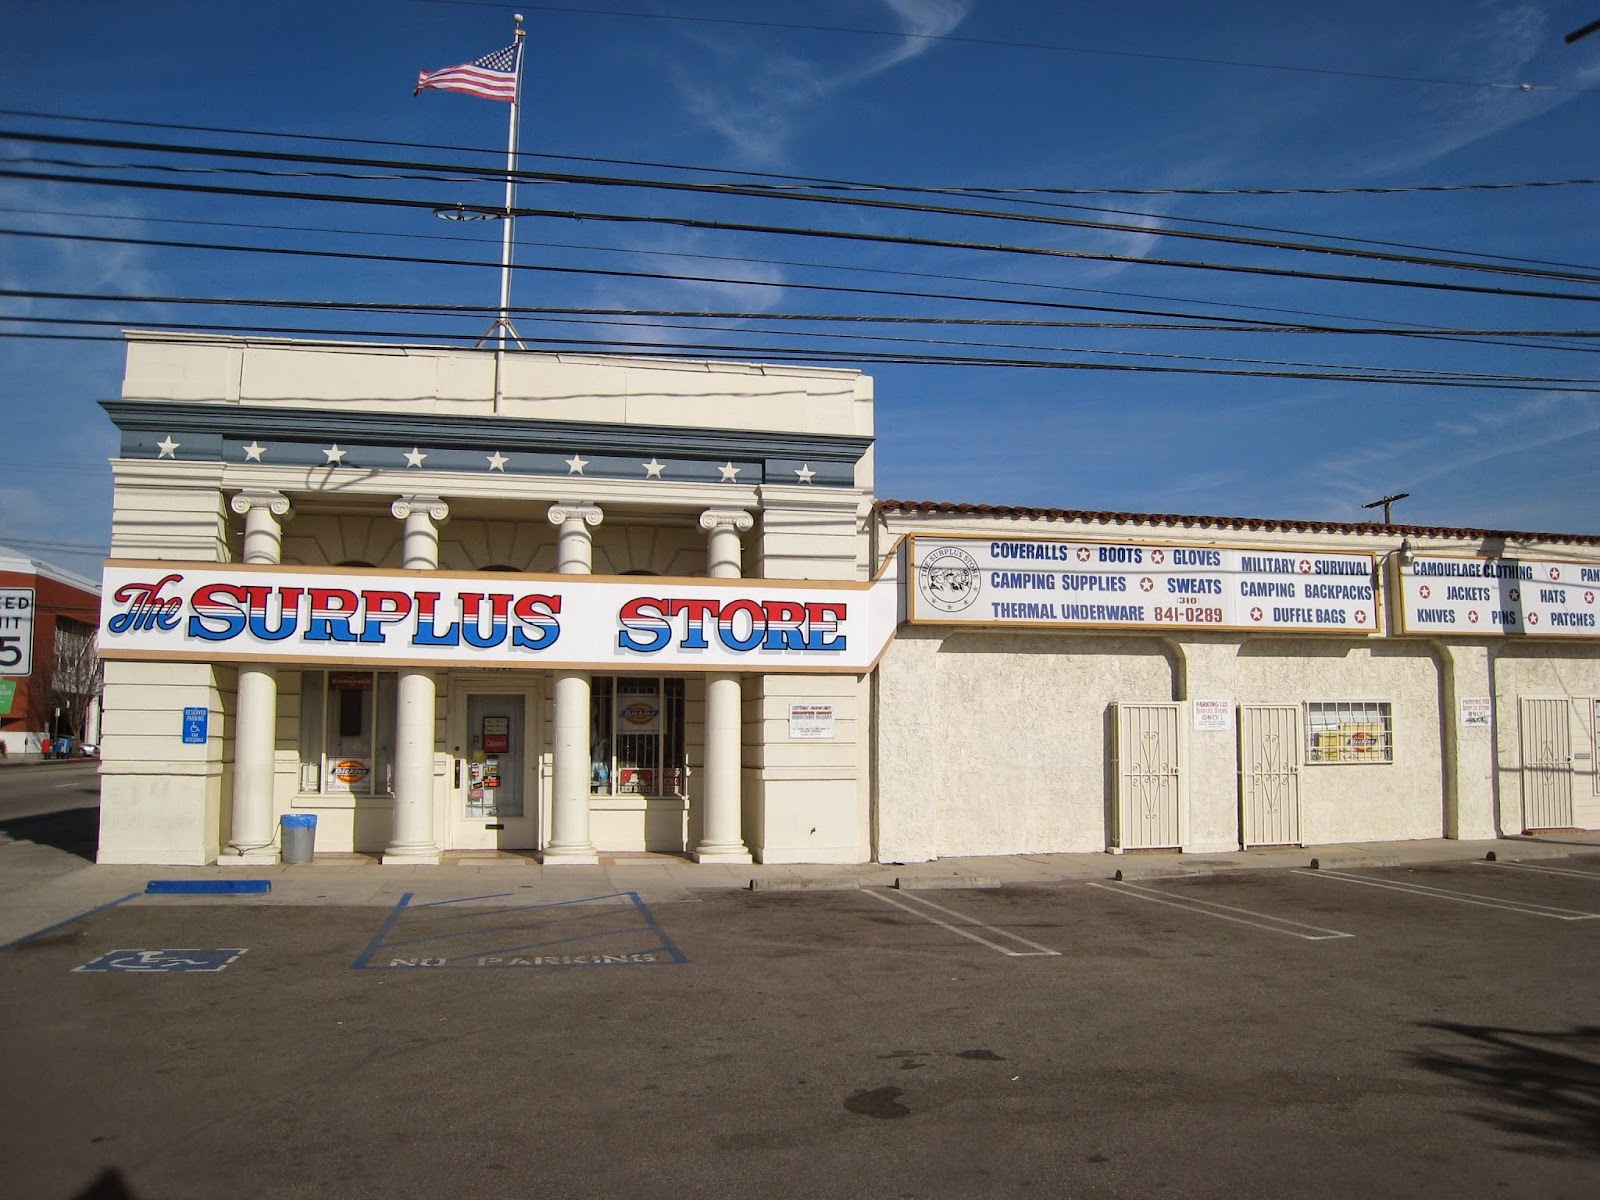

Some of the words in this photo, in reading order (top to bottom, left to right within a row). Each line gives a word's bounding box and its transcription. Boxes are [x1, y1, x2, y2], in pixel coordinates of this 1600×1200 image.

[990, 542, 1068, 561] COVERALLS
[1098, 547, 1142, 564] BOOTS
[1173, 549, 1221, 566] GLOVES
[921, 560, 931, 577] THE
[929, 548, 963, 562] SURPLUS
[963, 554, 980, 580] STORE
[1241, 556, 1295, 573] MILITARY
[1314, 560, 1370, 575] SURVIVAL
[1413, 561, 1481, 577] CAMOUFLAGE
[1483, 564, 1533, 580] CLOTHING
[1580, 568, 1600, 582] PAN
[990, 572, 1055, 590] CAMPING
[1061, 574, 1126, 592] SUPPLIES
[1167, 577, 1222, 595] SWEATS
[1240, 581, 1295, 598] CAMPING
[1304, 584, 1372, 600] BACKPACKS
[0, 597, 29, 609] ED
[1446, 586, 1491, 601] JACKETS
[1540, 589, 1566, 604] HATS
[107, 574, 184, 634] The
[188, 583, 561, 650] SURPLUS
[619, 596, 847, 652] STORE
[991, 602, 1057, 619] THERMAL
[1061, 604, 1145, 621] UNDERWARE
[1154, 607, 1223, 622] 841-0289
[1273, 607, 1313, 623] DUFFLE
[1315, 608, 1346, 624] BAGS
[1417, 608, 1455, 623] KNIVES
[1491, 611, 1516, 625] PINS
[1550, 612, 1596, 627] PATCHES
[0, 616, 22, 629] IT
[390, 958, 447, 968] NO
[477, 953, 656, 967] PARKING
